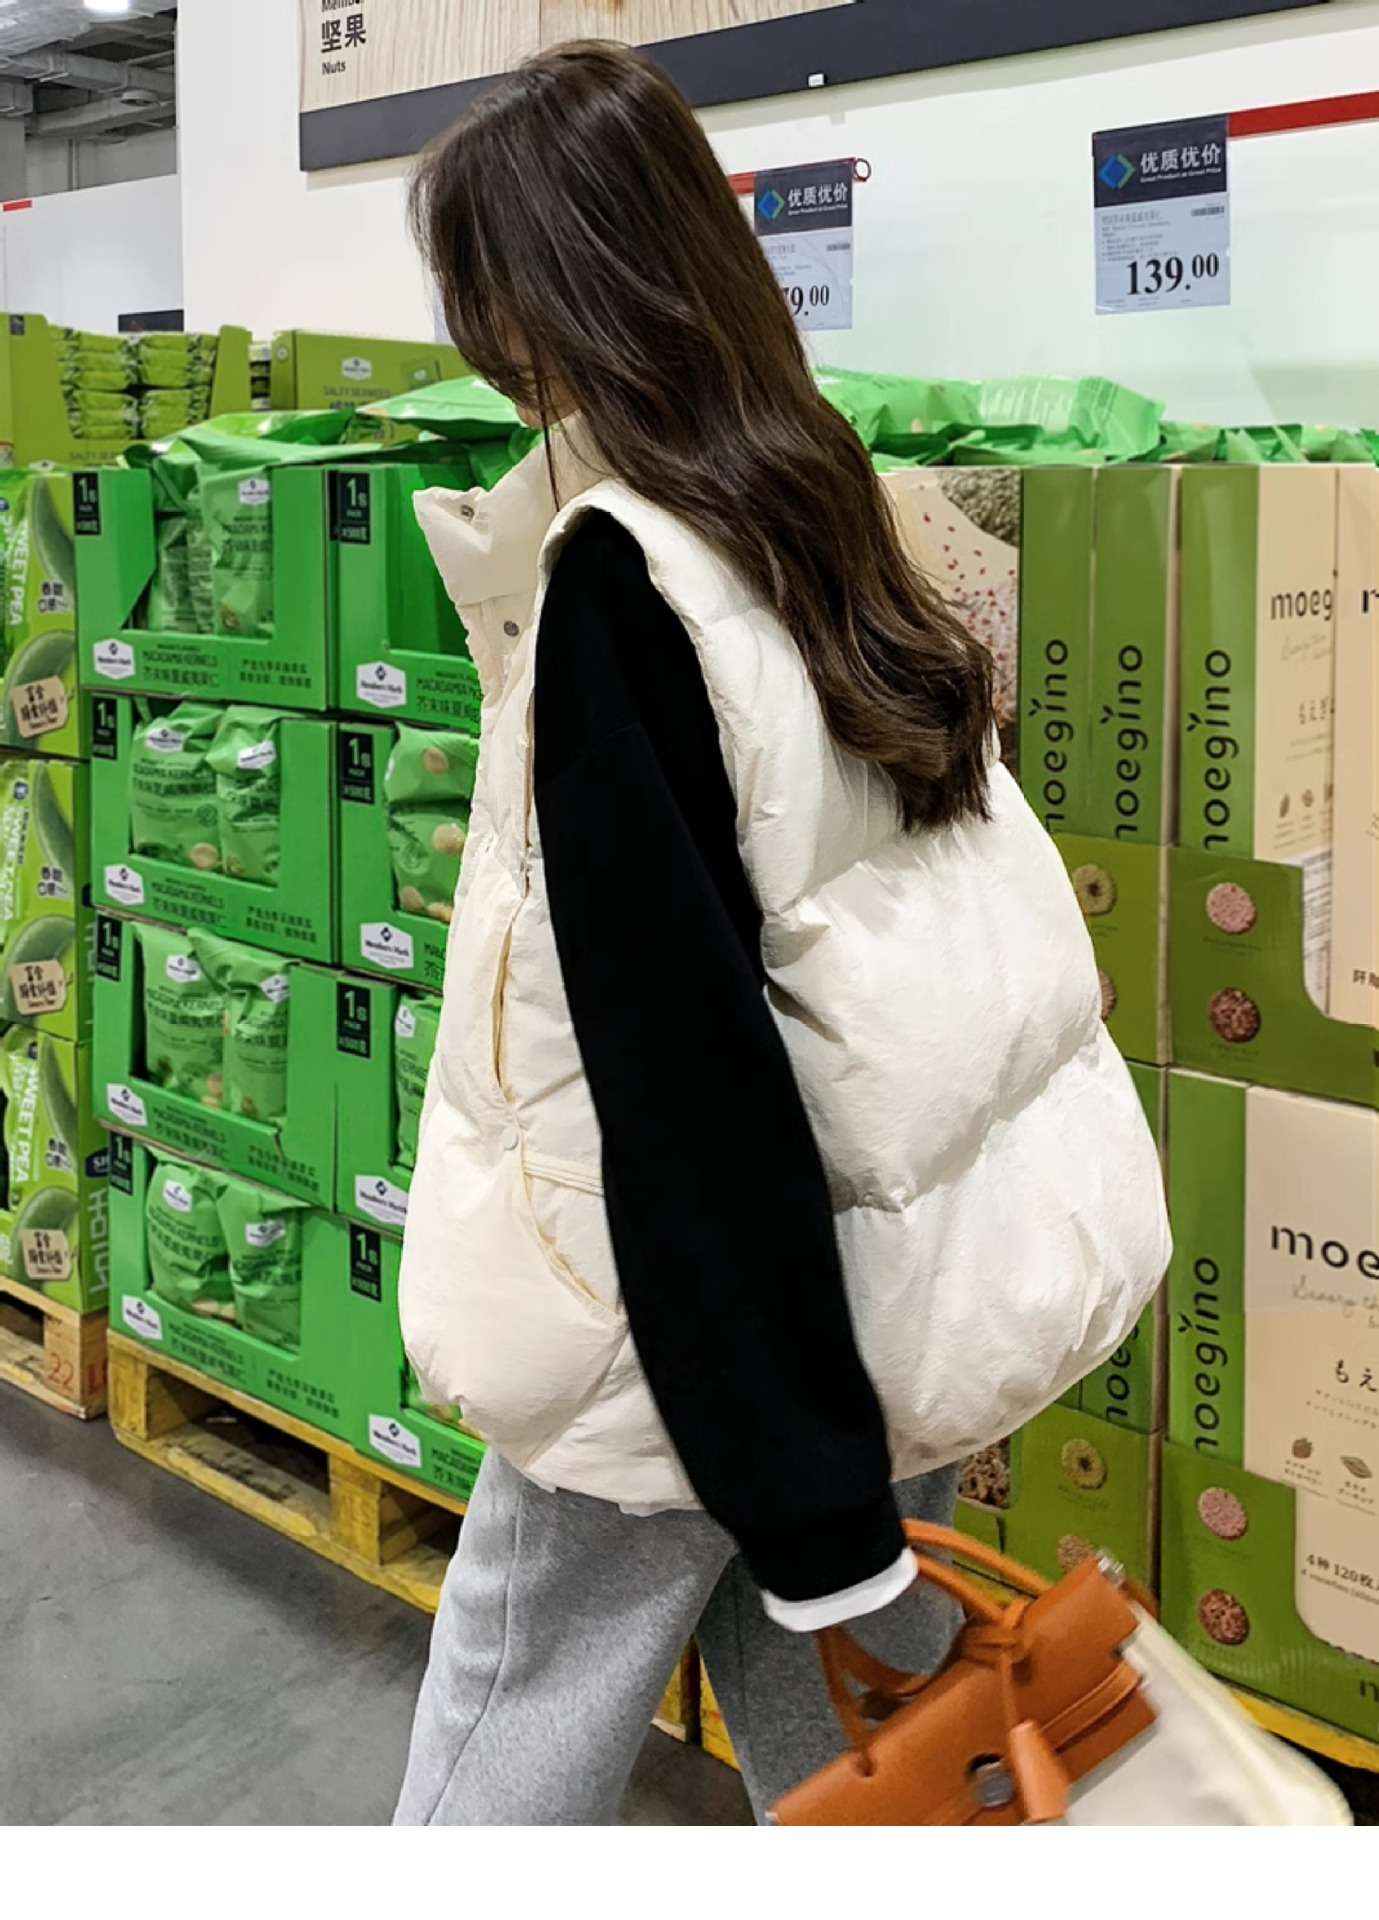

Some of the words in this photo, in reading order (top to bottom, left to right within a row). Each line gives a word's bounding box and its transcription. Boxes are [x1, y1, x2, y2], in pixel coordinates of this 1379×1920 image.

[321, 13, 366, 53] 坚果
[322, 61, 346, 75] Nuts
[1140, 142, 1221, 175] 优质优价
[787, 182, 848, 208] 优质优价
[1127, 252, 1219, 295] 139.00
[16, 1141, 32, 1182] PEA
[1271, 1225, 1379, 1280] moe
